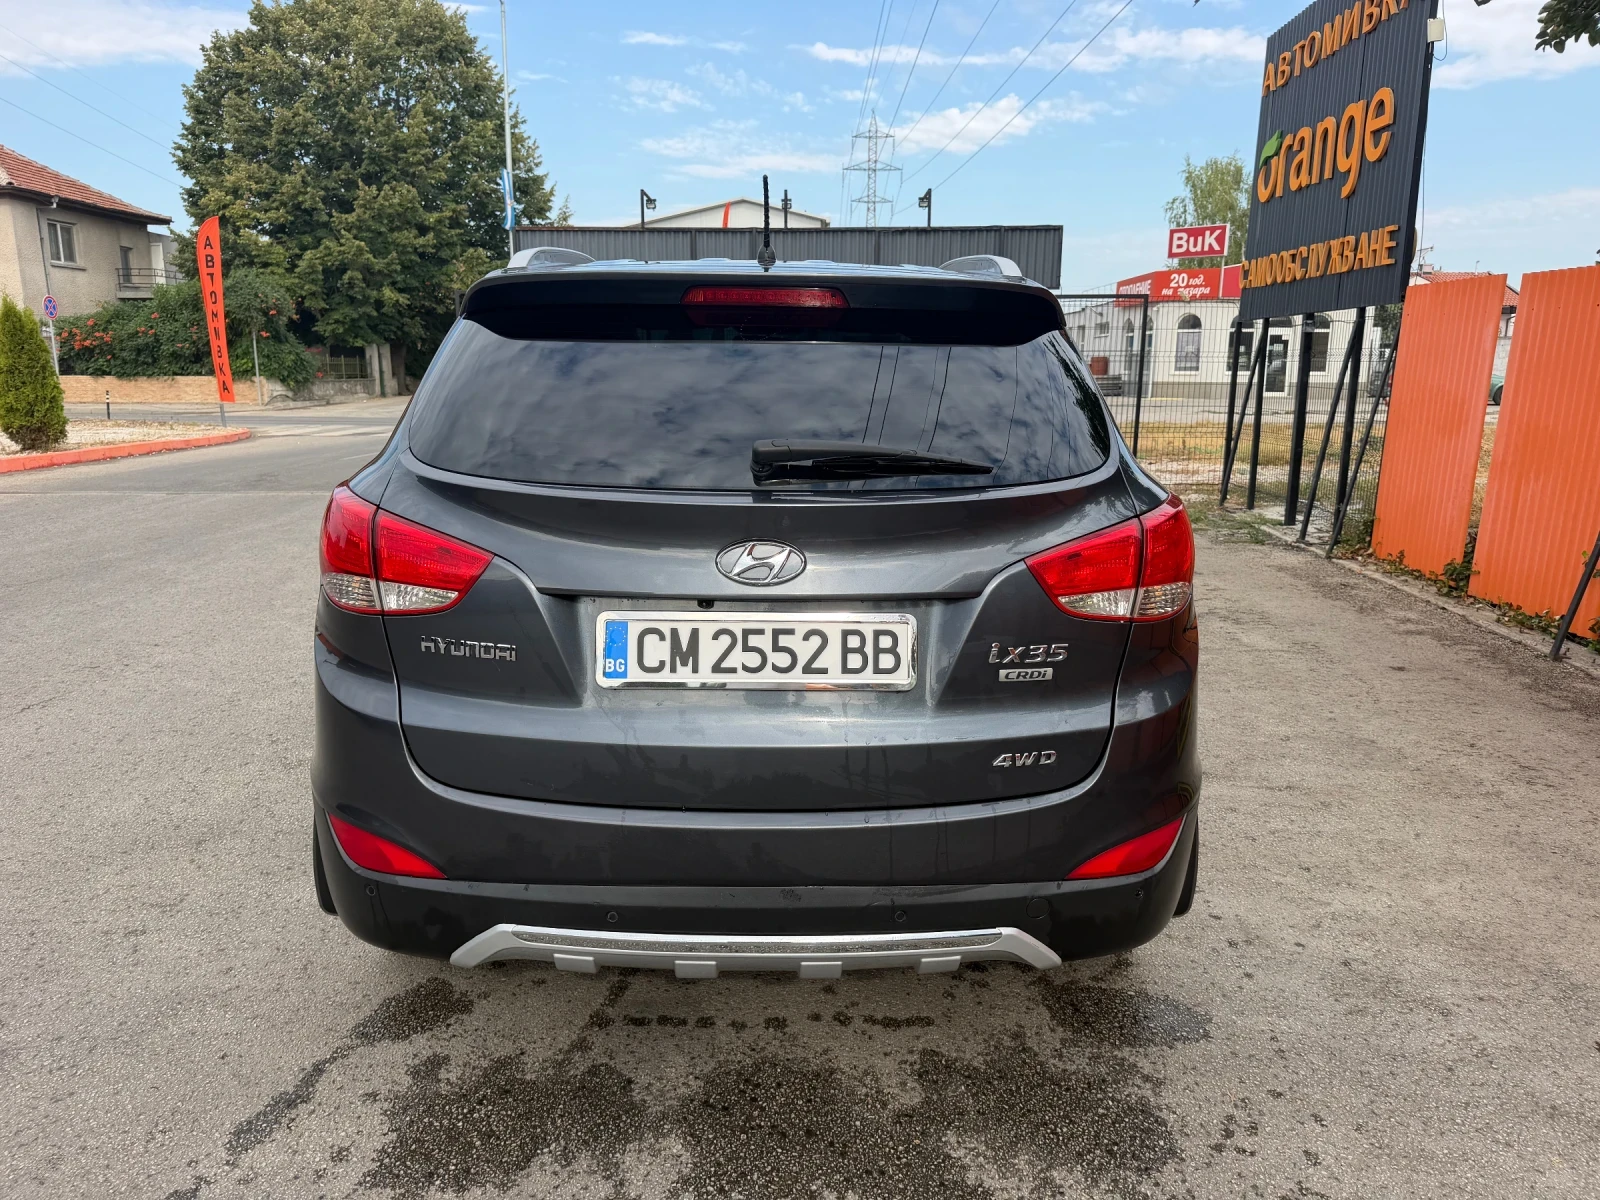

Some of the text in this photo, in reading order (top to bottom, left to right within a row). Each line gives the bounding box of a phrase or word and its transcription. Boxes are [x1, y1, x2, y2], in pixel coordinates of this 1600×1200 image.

[1262, 0, 1420, 96] АВТОМИВК
[1257, 87, 1394, 203] orange
[1239, 225, 1398, 289] САМООБСЛУЖВАНЕ
[1170, 273, 1205, 287] 20 год.
[203, 235, 230, 394] АВТОМИВКА
[421, 635, 516, 661] HYUNDAI
[711, 628, 829, 674] 2552
[989, 643, 1068, 663] ix35
[605, 658, 625, 672] BG
[1004, 670, 1048, 680] CRDi
[992, 751, 1057, 767] 4WD
